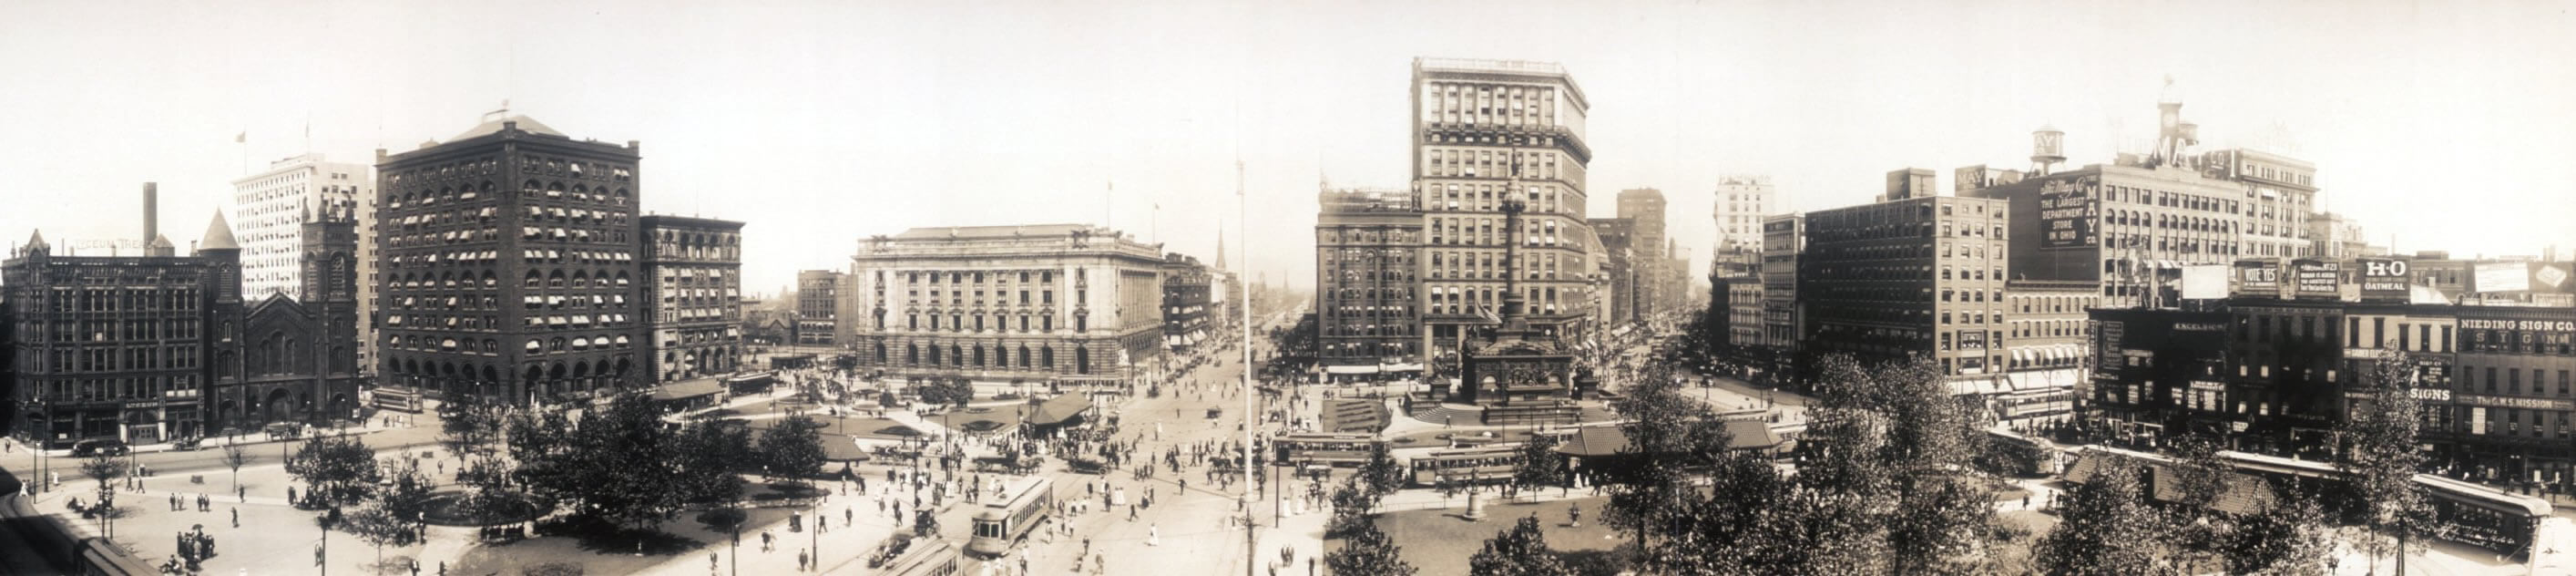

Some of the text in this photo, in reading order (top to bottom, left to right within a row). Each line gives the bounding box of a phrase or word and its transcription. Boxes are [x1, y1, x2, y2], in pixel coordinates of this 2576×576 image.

[2153, 136, 2204, 170] MAY
[1957, 170, 1984, 187] MAY
[2056, 180, 2076, 198] May
[2041, 197, 2084, 209] THE LARGEST
[2086, 185, 2097, 232] MAY
[2042, 208, 2083, 220] DEPARTMENT
[2052, 220, 2072, 230] STORE
[2049, 230, 2076, 241] IN OHIO
[75, 239, 117, 249] LYCEUM
[2244, 269, 2275, 282] VOTE YES
[2365, 283, 2406, 291] OATMEAL
[2461, 320, 2516, 329] NIEDING
[2520, 321, 2554, 332] SIGN
[2409, 388, 2451, 401] SIGNS
[2477, 396, 2491, 406] The
[2516, 398, 2553, 409] MISSION
